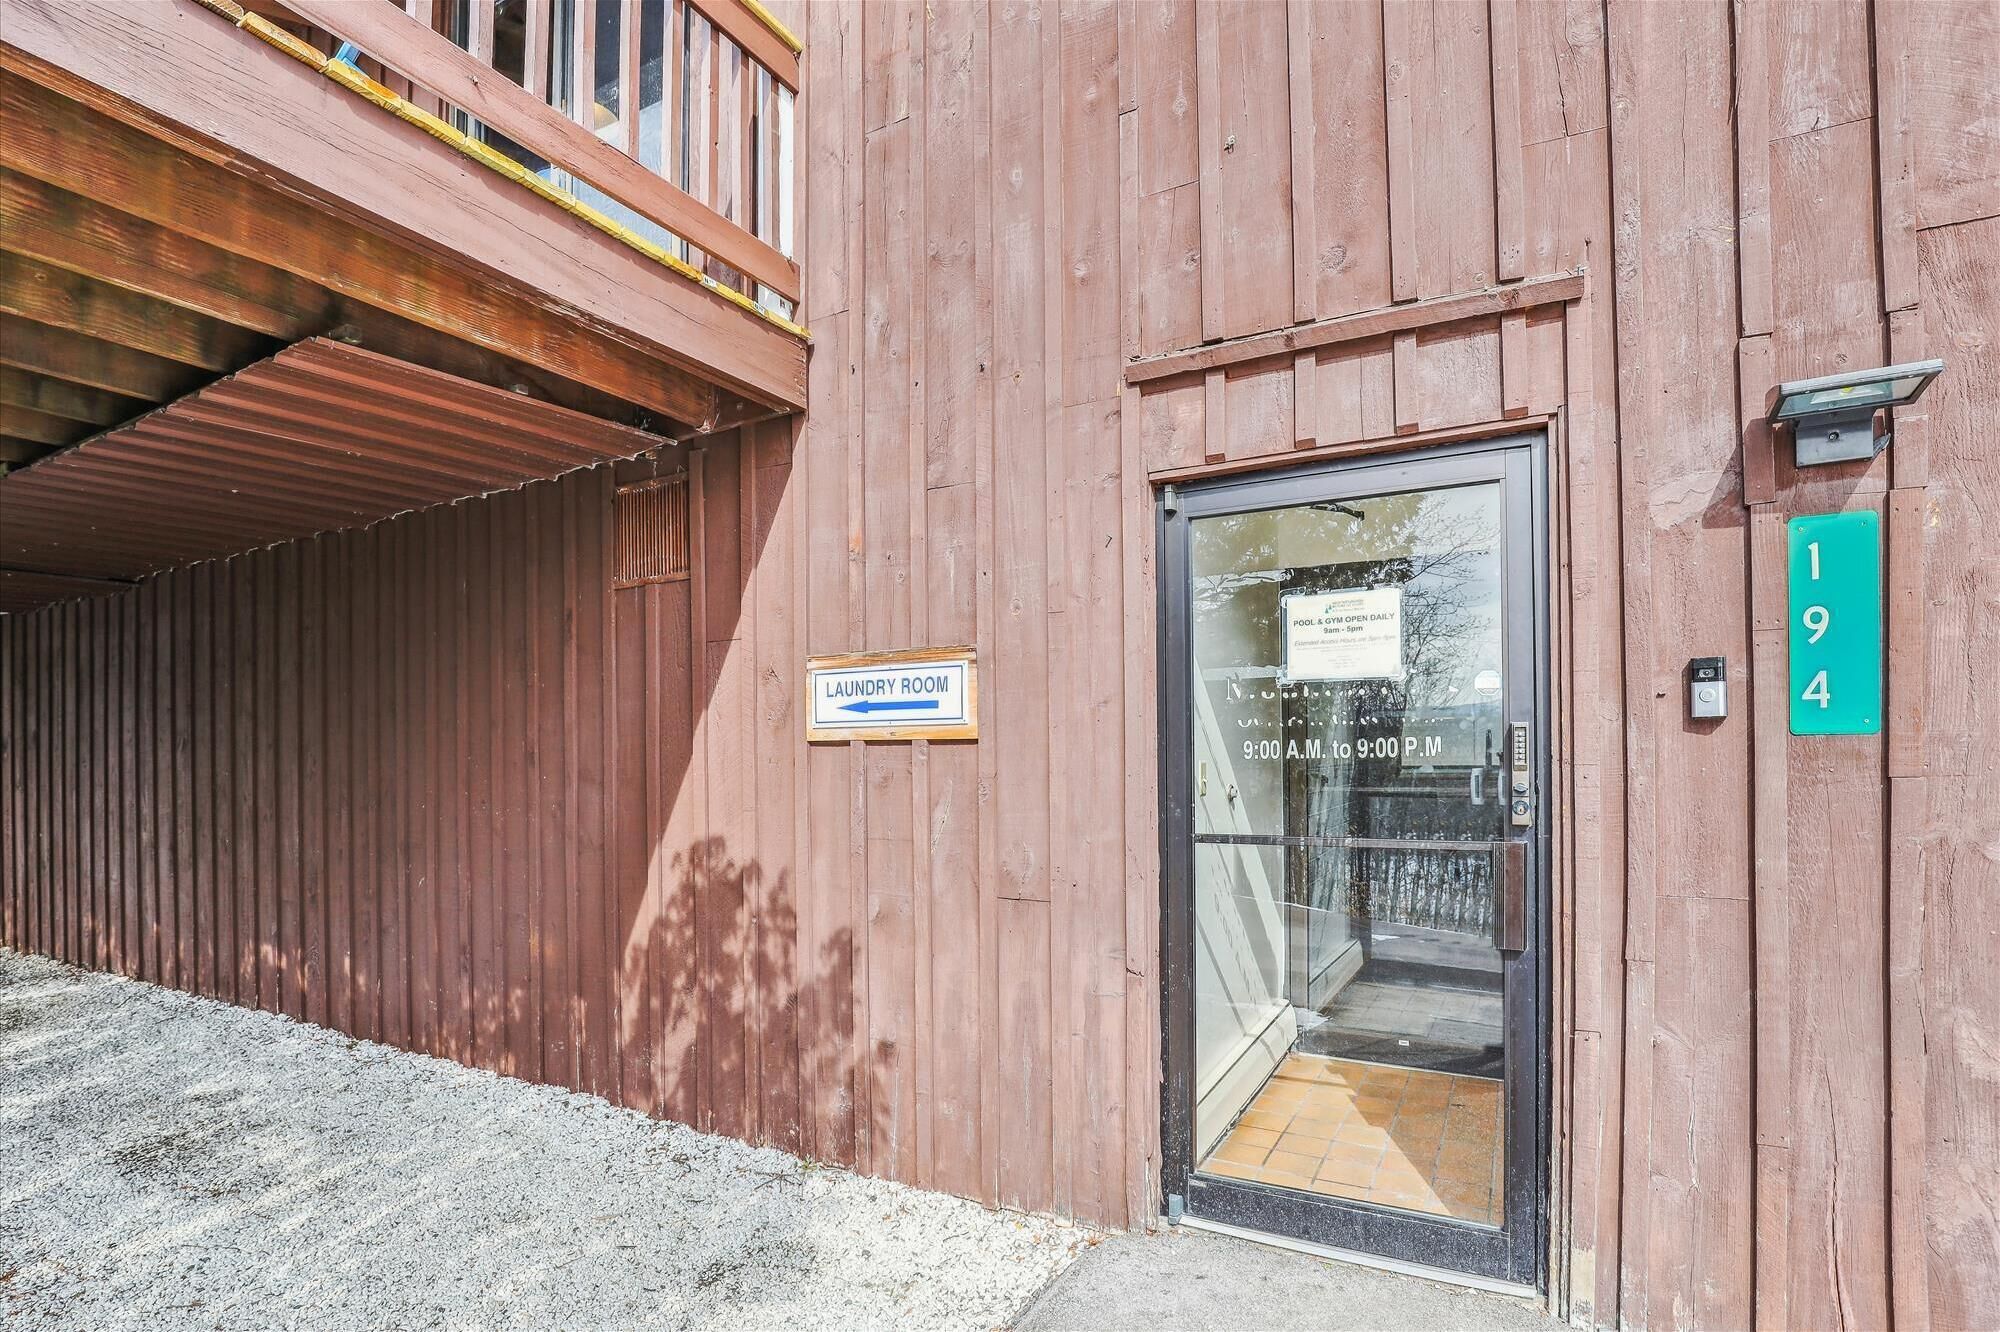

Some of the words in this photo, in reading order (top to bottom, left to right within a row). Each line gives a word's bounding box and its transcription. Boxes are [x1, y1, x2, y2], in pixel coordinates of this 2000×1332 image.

[1293, 619, 1315, 627] POOL
[1325, 616, 1343, 624] GYM
[1345, 615, 1368, 623] OPEN
[1370, 612, 1395, 621] DAILY
[1346, 625, 1363, 633] 5pm
[1801, 541, 1831, 709] 194
[826, 678, 896, 698] LAUNDRY
[901, 675, 948, 694] ROOM
[1243, 739, 1281, 760] 9:00
[1285, 738, 1326, 759] A.M.
[1332, 740, 1352, 759] to
[1357, 736, 1399, 759] 9:00
